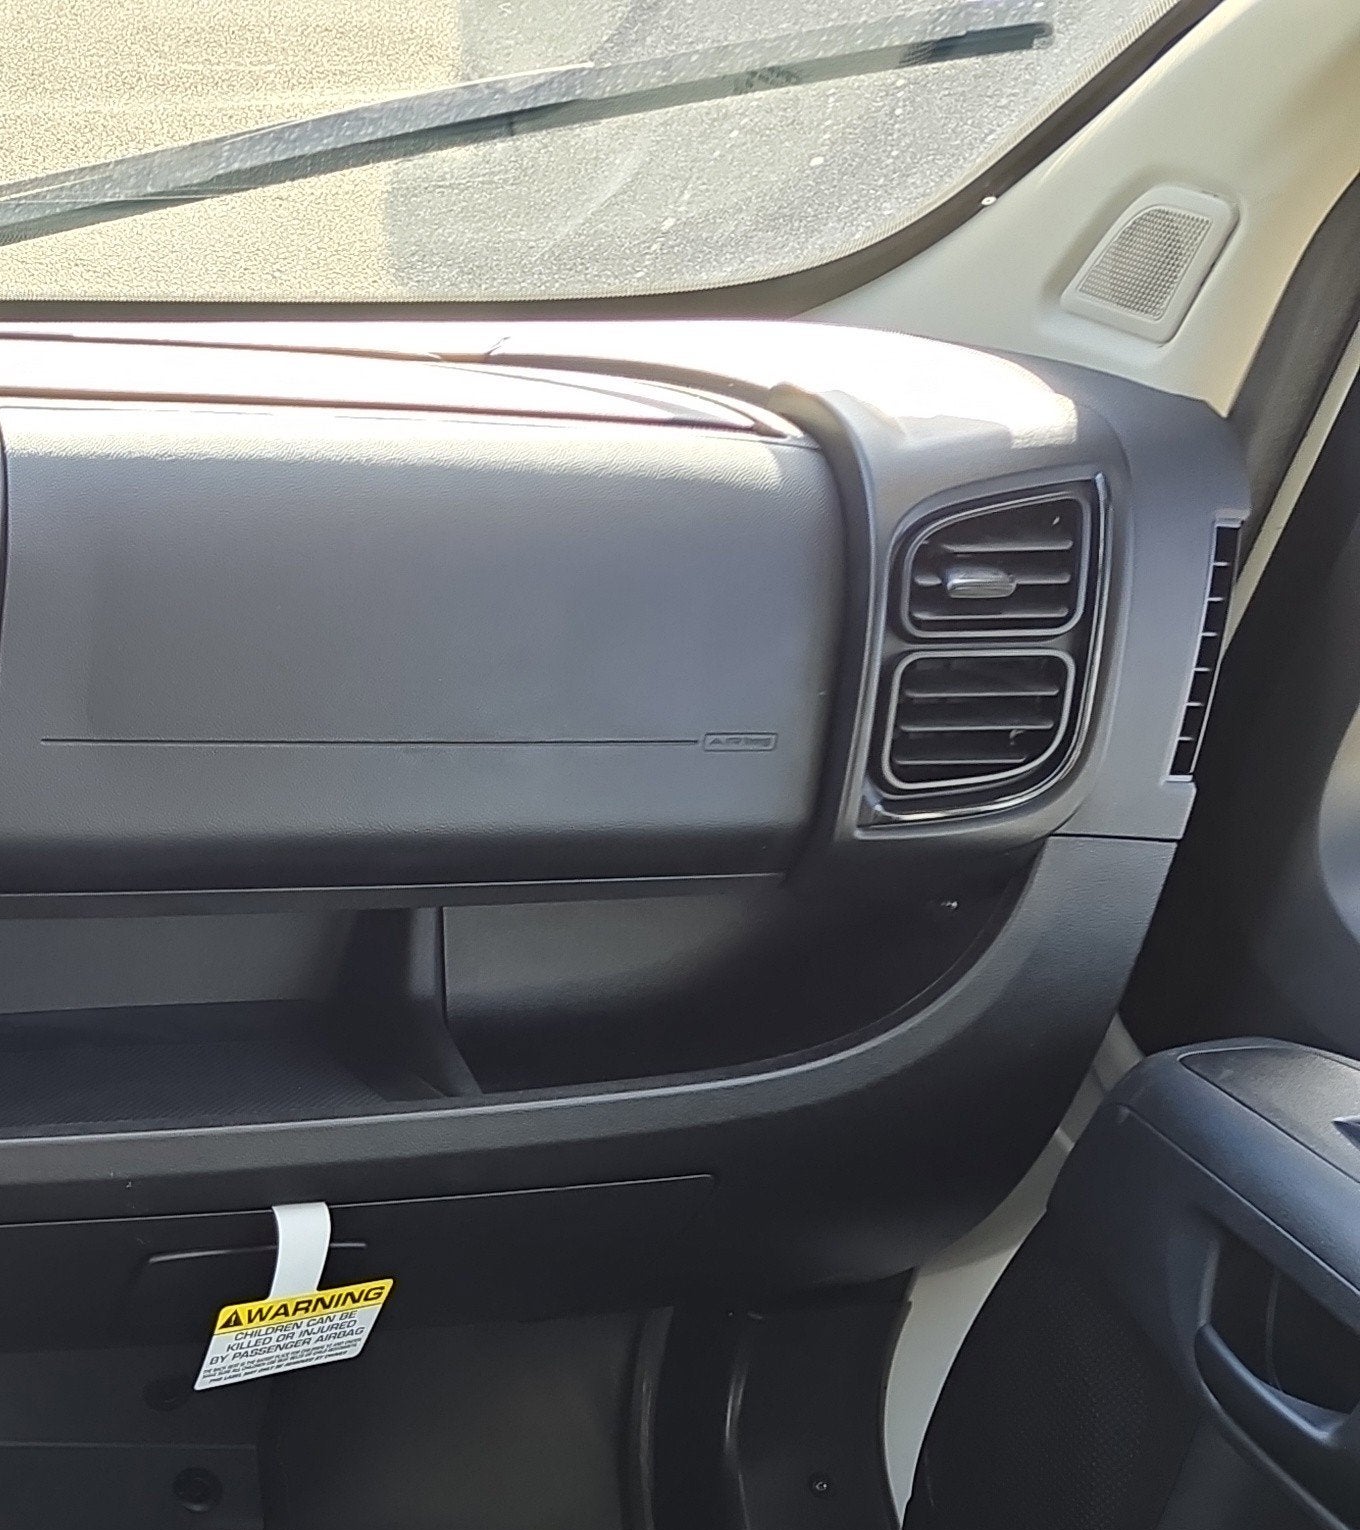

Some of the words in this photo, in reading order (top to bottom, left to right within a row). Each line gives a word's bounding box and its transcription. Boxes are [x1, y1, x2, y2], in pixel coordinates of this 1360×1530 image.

[246, 1285, 386, 1325] WARNING
[226, 1336, 274, 1353] KILLED
[275, 1333, 296, 1344] OR
[298, 1319, 357, 1339] INJURED
[234, 1320, 304, 1341] CHILDREN
[306, 1315, 336, 1328] CAN
[338, 1310, 358, 1321] BE
[209, 1355, 230, 1366] BY
[232, 1337, 313, 1361] PASSENGER
[314, 1327, 366, 1345] AIRBAG
